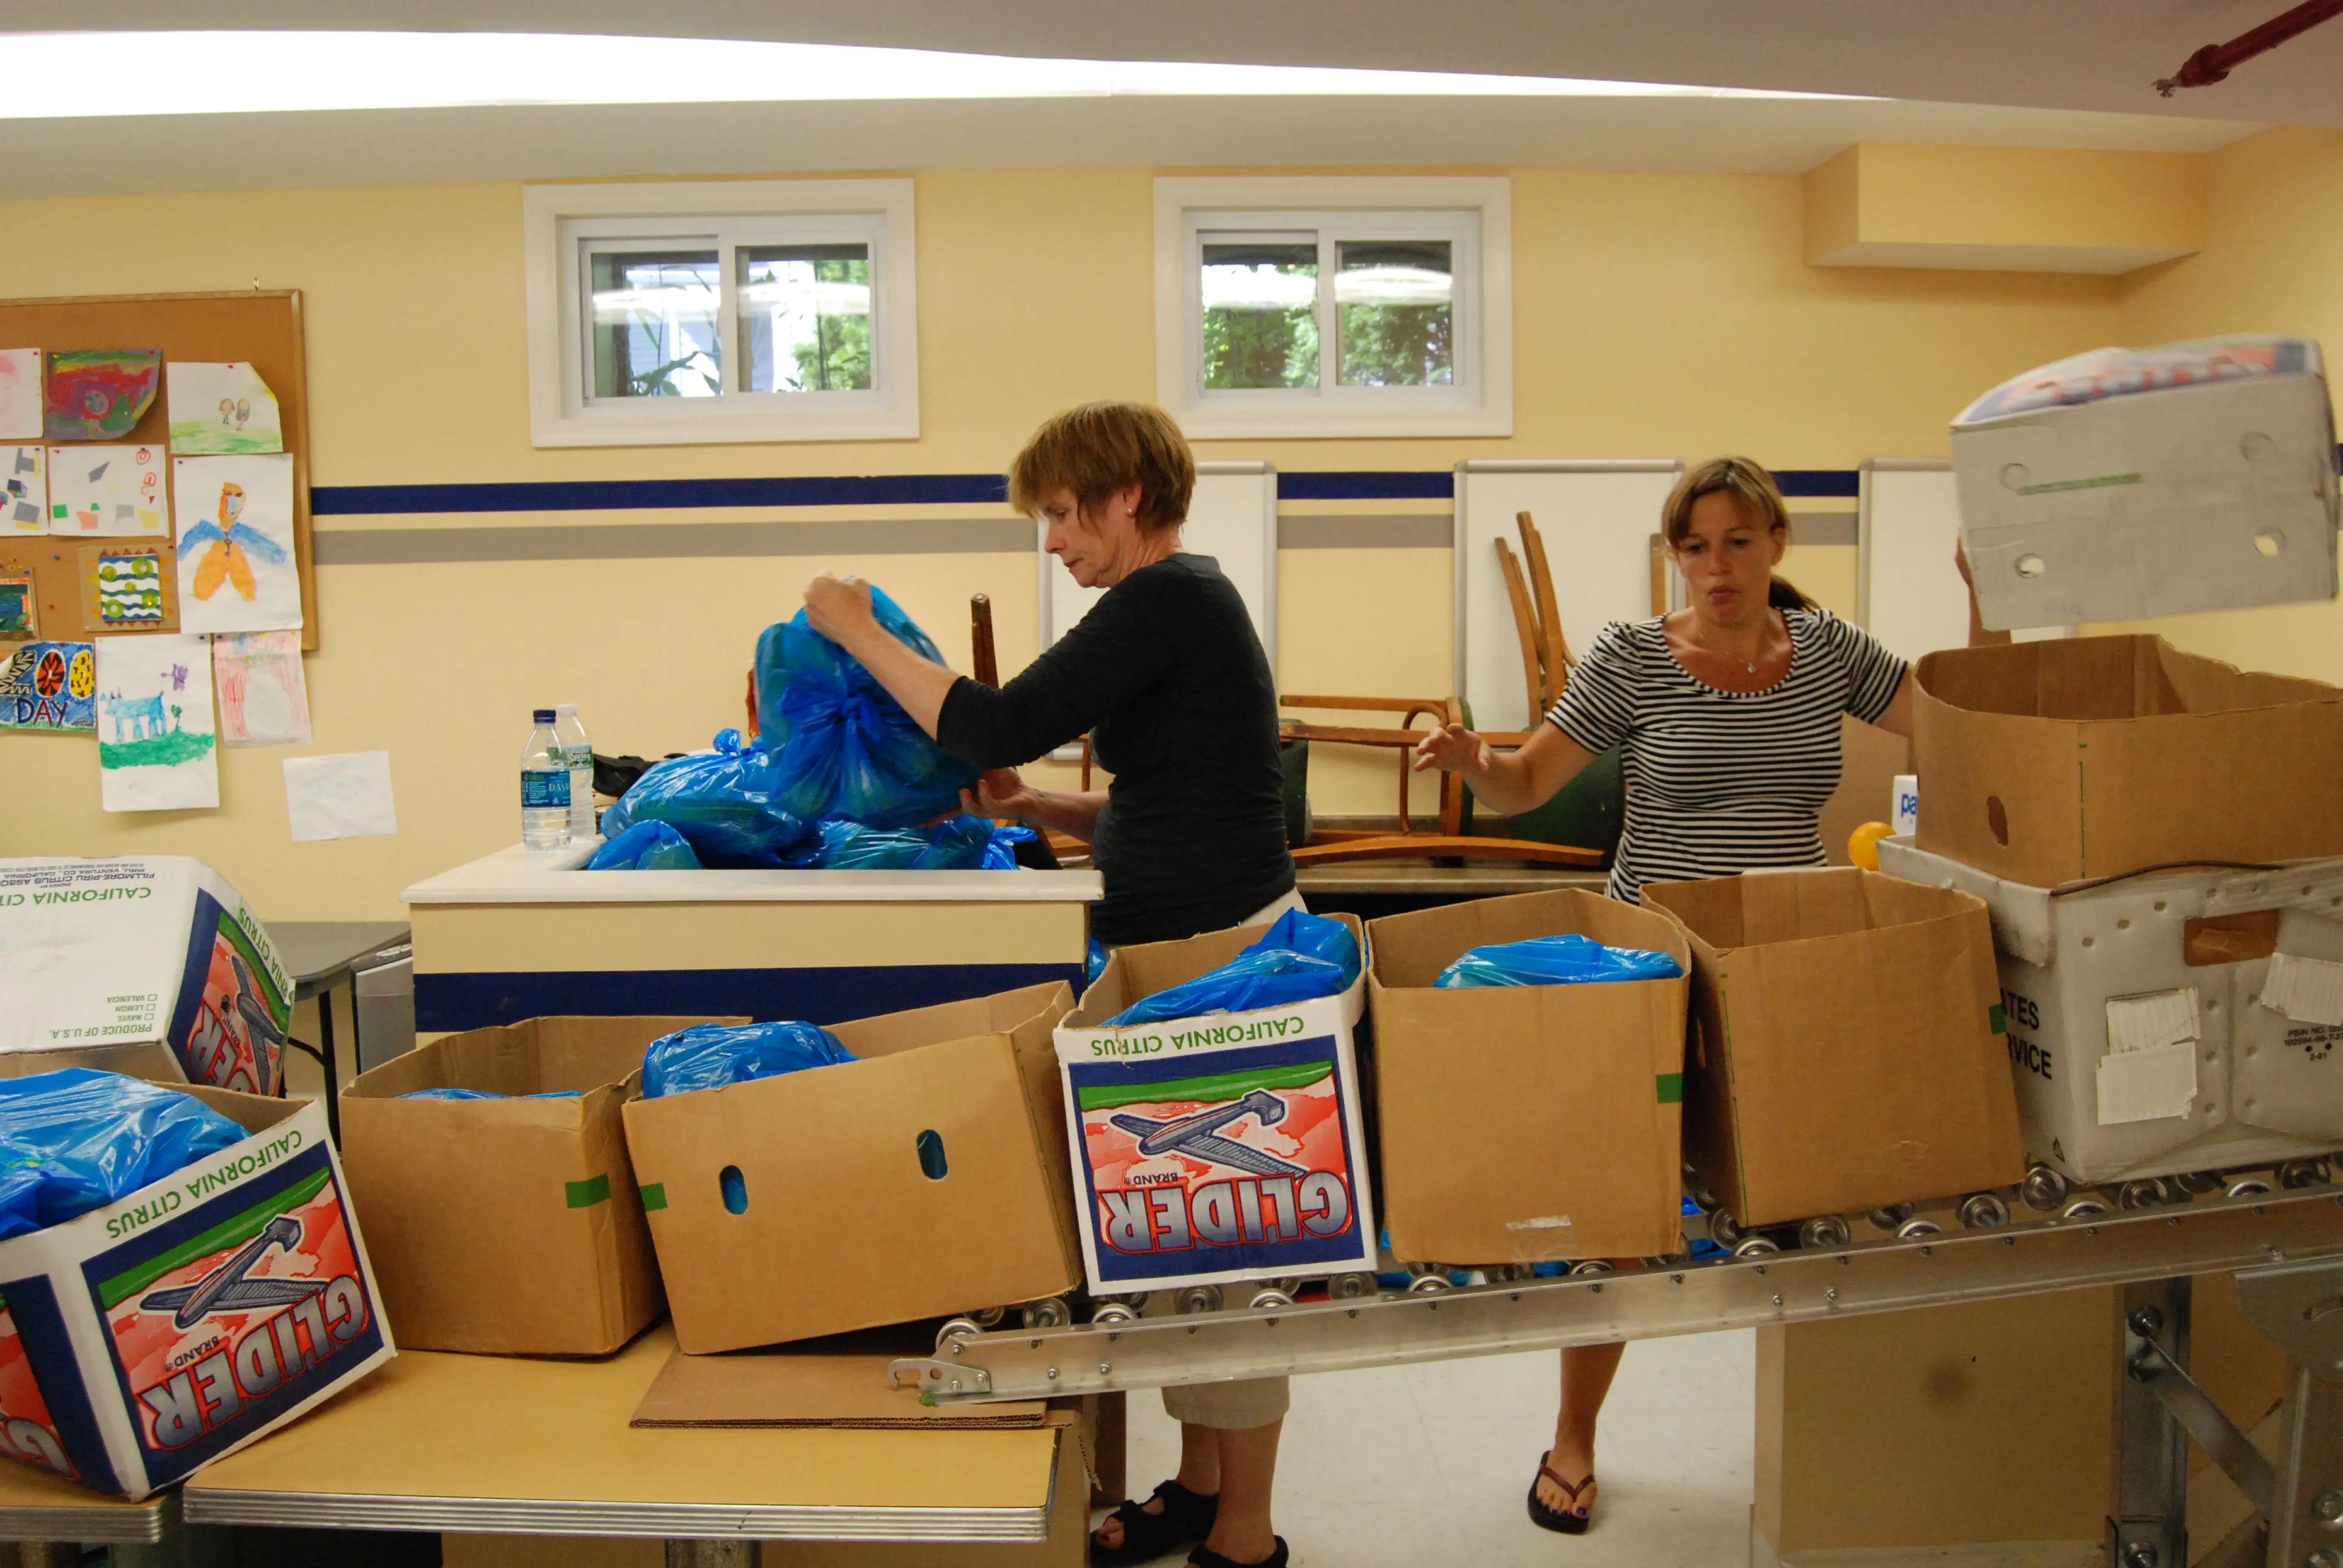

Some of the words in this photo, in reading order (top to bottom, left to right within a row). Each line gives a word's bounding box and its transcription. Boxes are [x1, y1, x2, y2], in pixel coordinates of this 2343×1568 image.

[16, 697, 68, 728] DAY
[1901, 793, 1917, 818] pa
[75, 872, 156, 881] FILLMORE-PIRU
[0, 894, 25, 906] CIT
[33, 887, 151, 905] CALIFORNIA
[240, 907, 270, 961] CITRUS
[49, 1028, 82, 1039] U.S.A.
[84, 1028, 99, 1037] OF
[102, 1024, 152, 1036] PRODUCE
[1170, 1016, 1305, 1050] CALIFORNIA
[1091, 1035, 1162, 1056] CITRUS
[187, 1129, 303, 1200] CALIFORNIA
[106, 1191, 181, 1240] CITRUS
[1099, 1171, 1352, 1255] GLIDER
[139, 1273, 370, 1451] GLIDER
